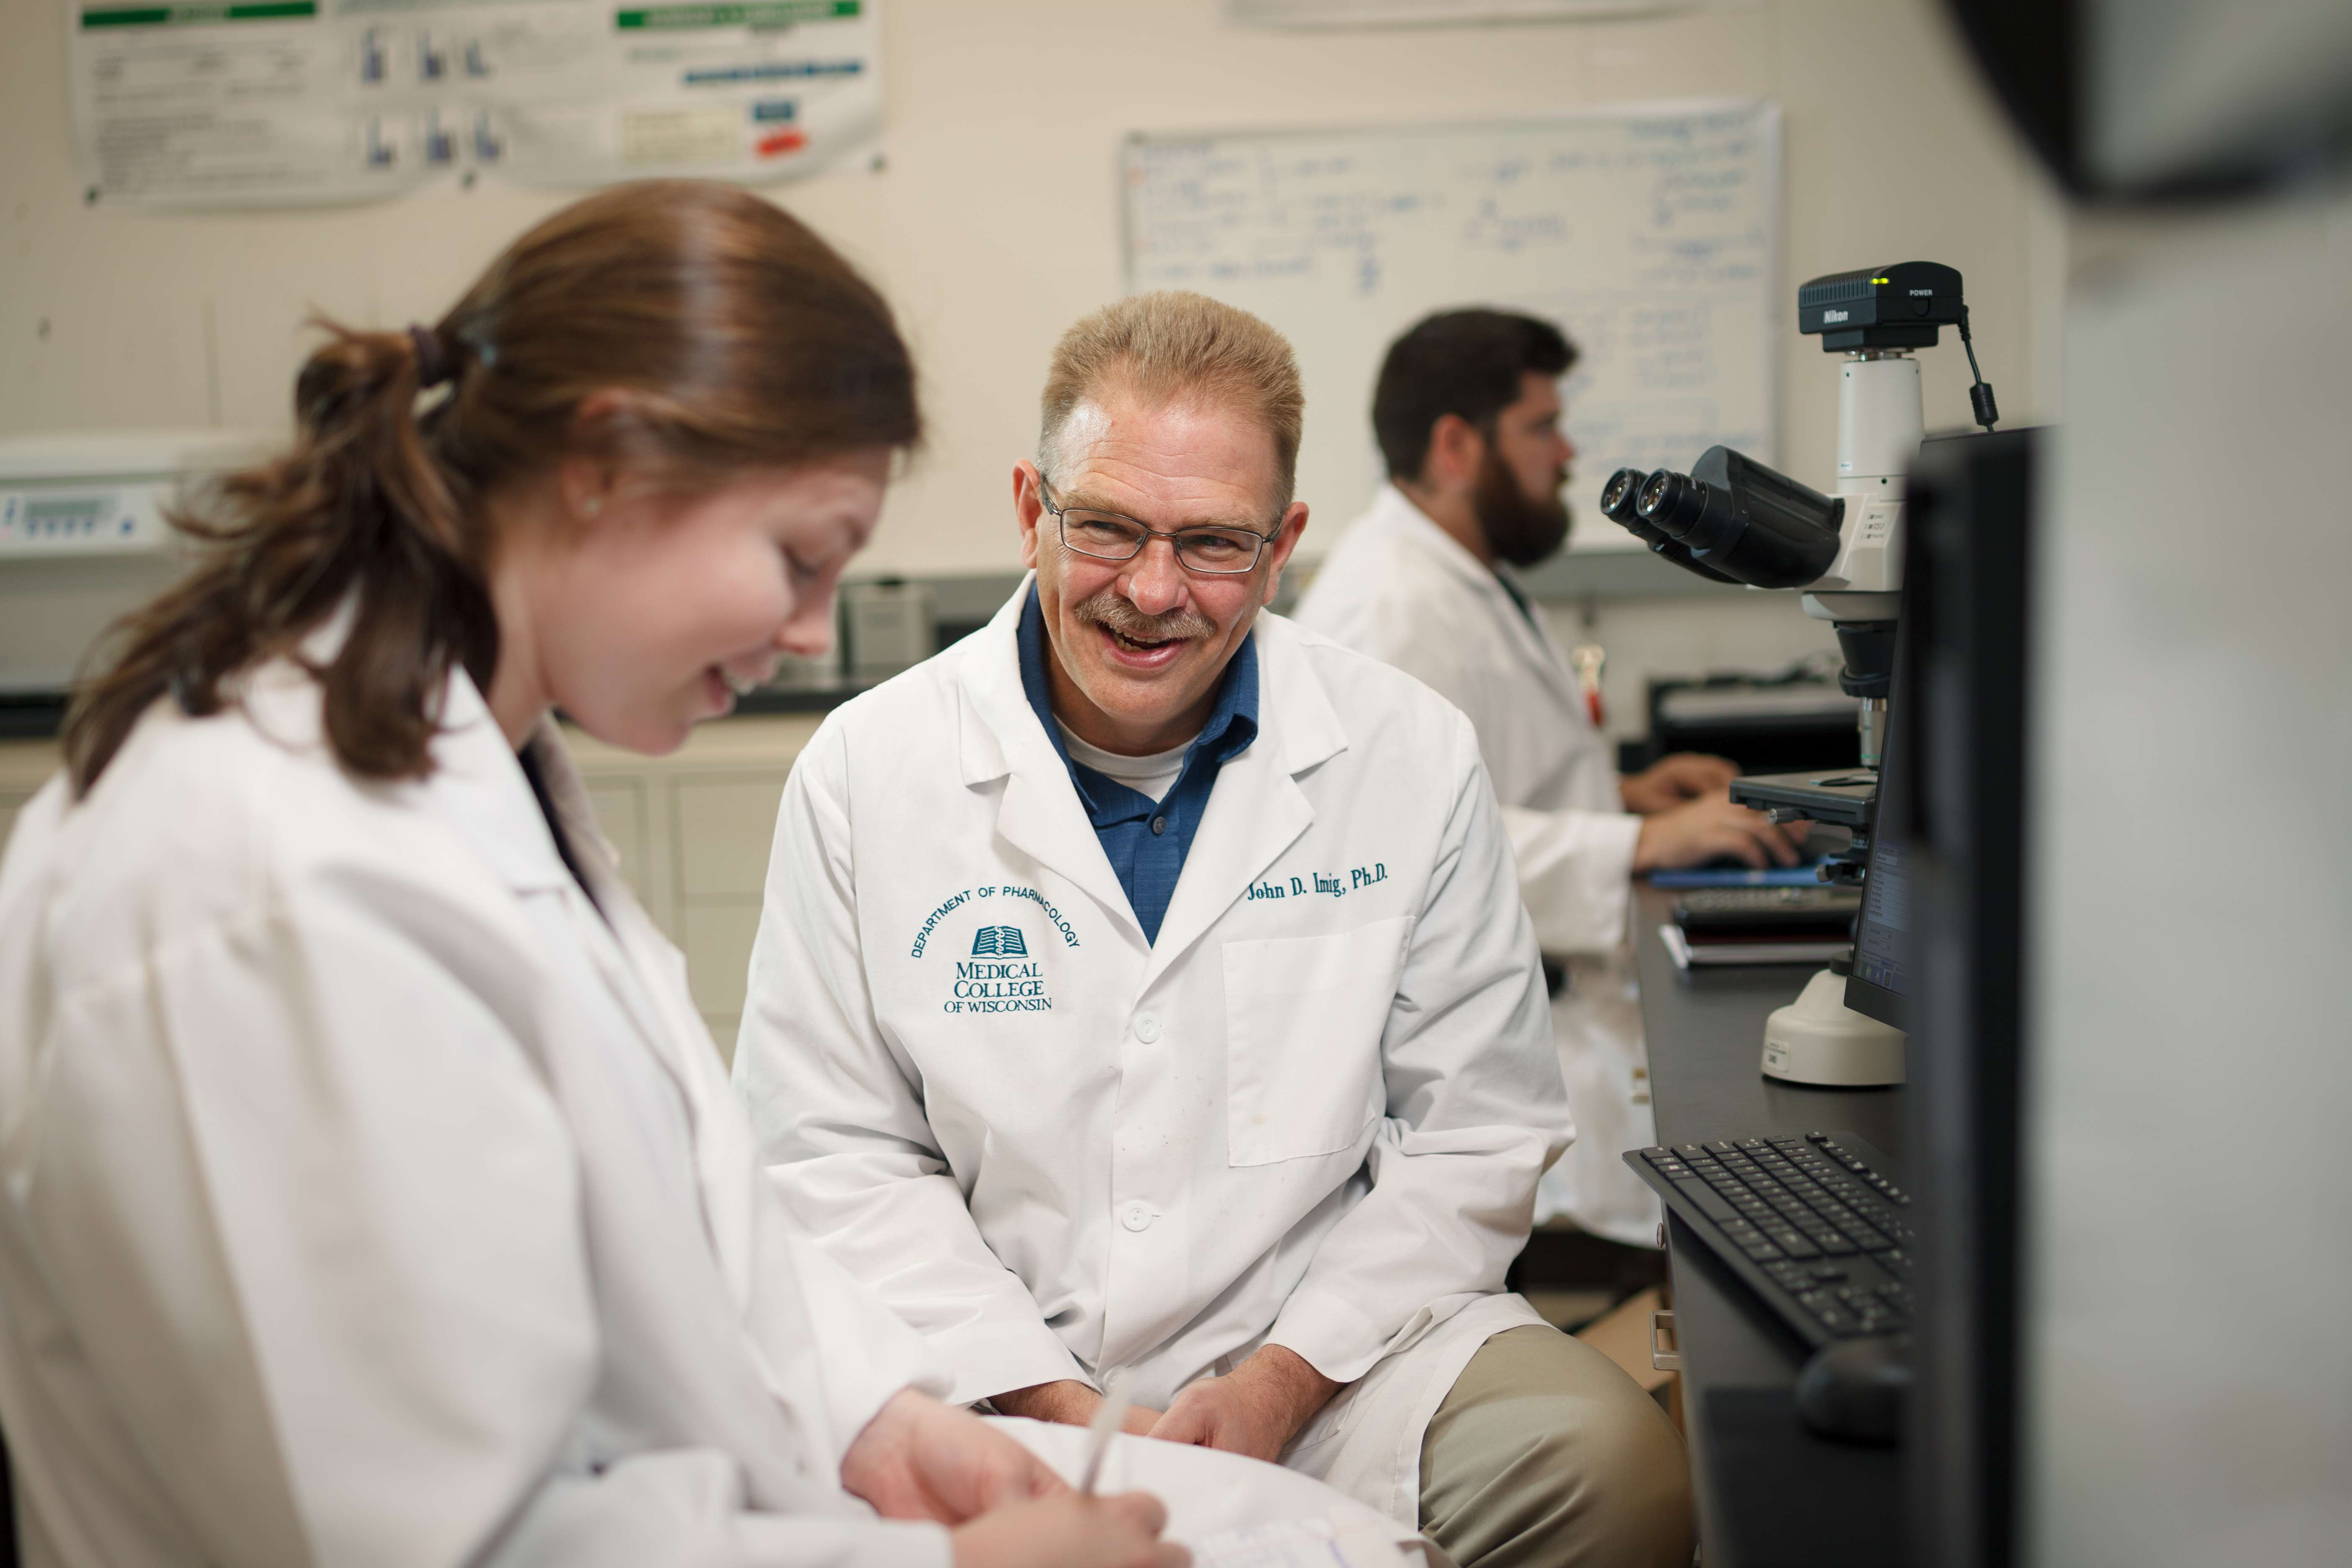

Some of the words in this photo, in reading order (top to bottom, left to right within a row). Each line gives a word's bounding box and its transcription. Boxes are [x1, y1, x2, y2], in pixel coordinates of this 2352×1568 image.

[1823, 310, 1848, 324] Nikon
[1248, 882, 1285, 900] John
[1290, 877, 1306, 896] D.
[1313, 873, 1346, 897] Imig,
[1351, 863, 1387, 889] Ph.D.
[911, 890, 971, 958] DEPARTMENT
[978, 887, 996, 897] OF
[1003, 887, 1080, 947] PHARMACOLOGY
[957, 962, 1043, 979] MEDICAL
[954, 980, 1044, 998] COLLEGE
[944, 1001, 965, 1013] OF
[968, 998, 1052, 1013] WISCONSIN
